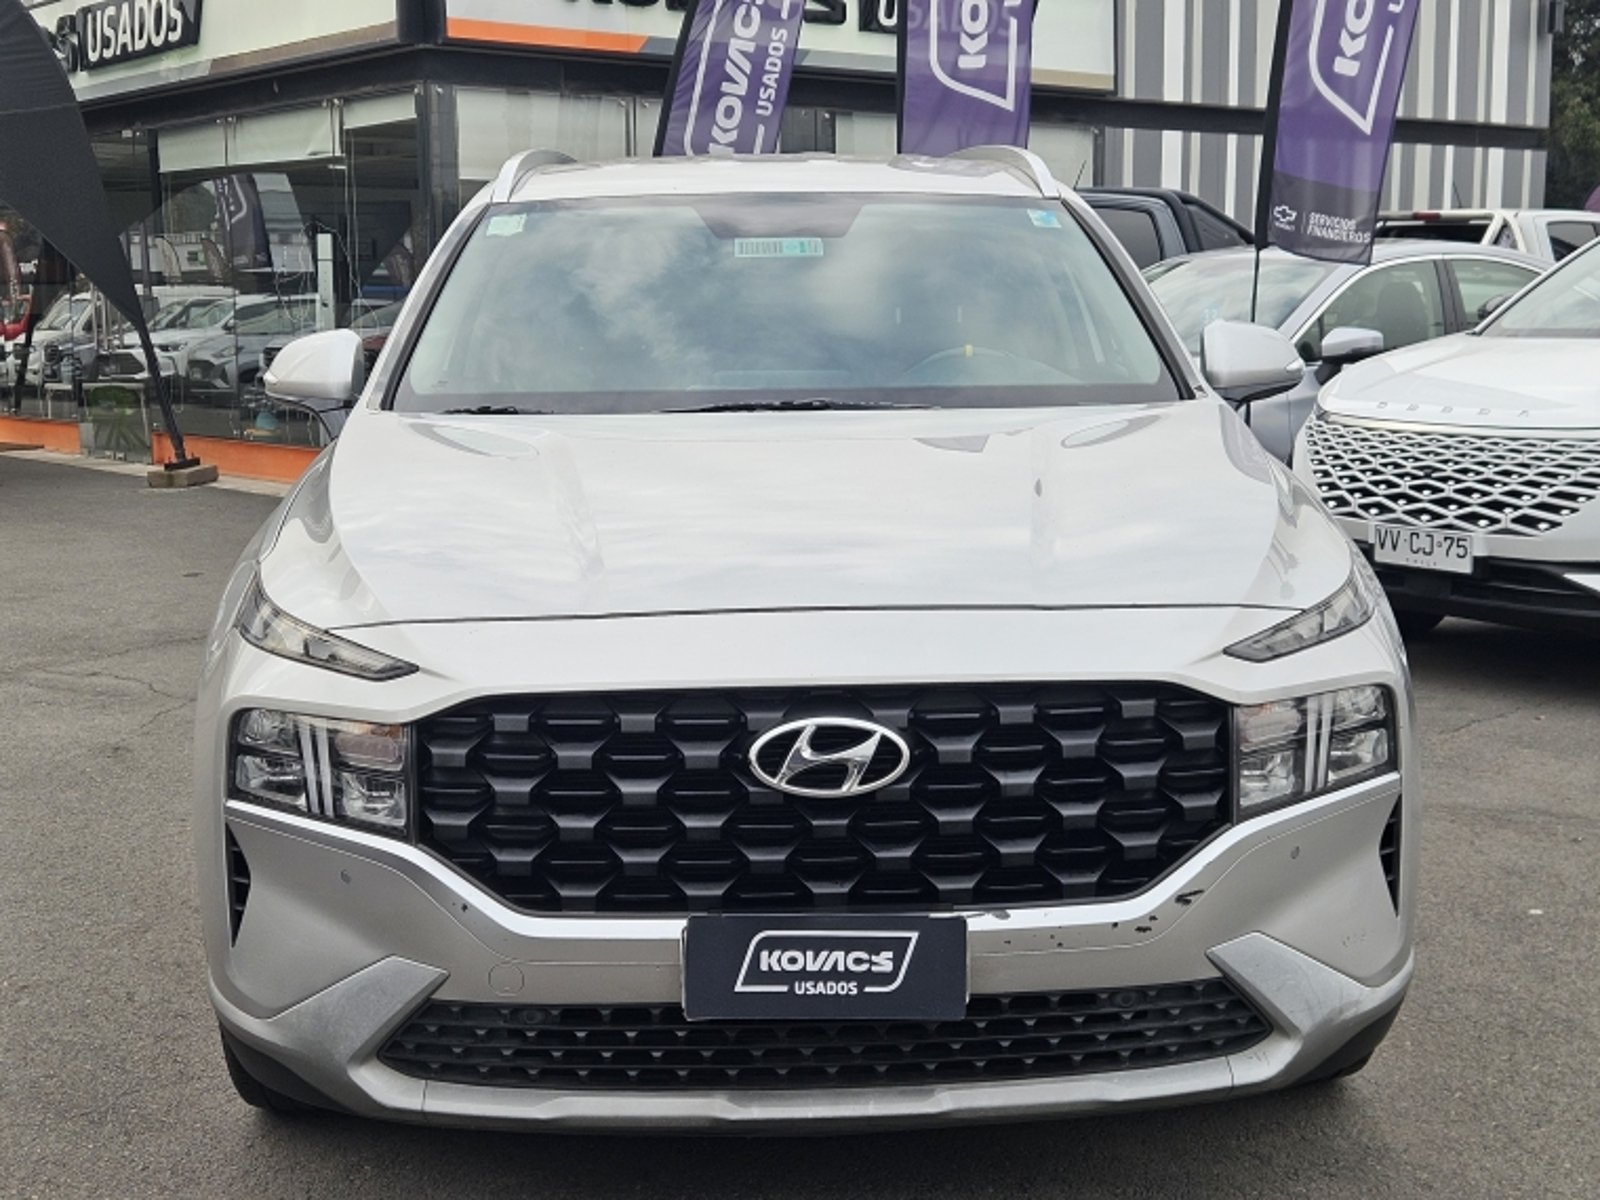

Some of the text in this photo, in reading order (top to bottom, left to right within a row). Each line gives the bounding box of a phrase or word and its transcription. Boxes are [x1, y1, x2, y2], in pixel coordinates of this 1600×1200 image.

[87, 0, 182, 62] USADOS
[707, 0, 764, 154] KOVAC
[755, 27, 788, 117] USADOS
[1309, 212, 1357, 231] SERVICIOS
[759, 950, 894, 973] KOVACS
[794, 980, 859, 996] USADOS
